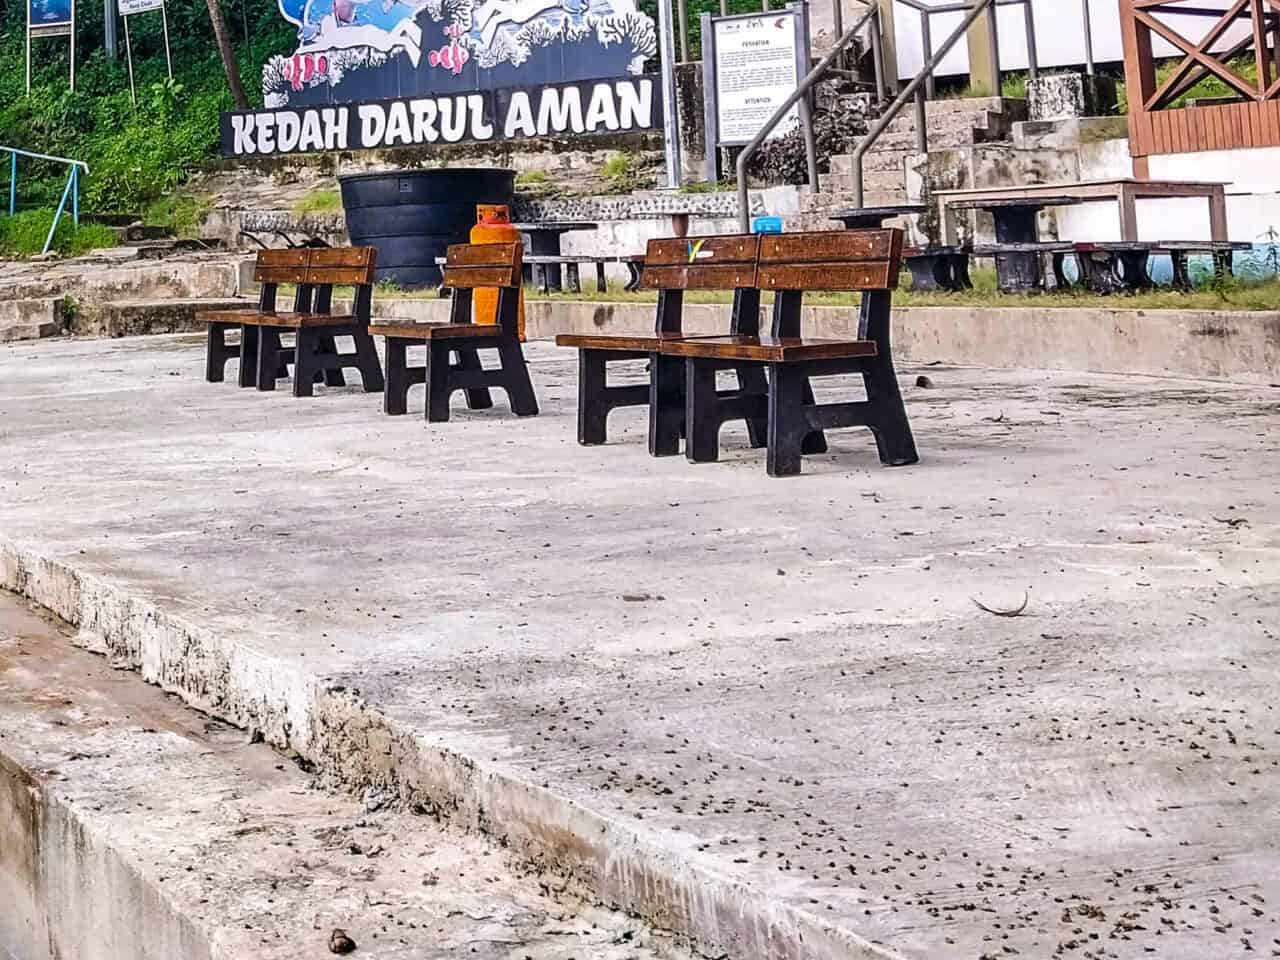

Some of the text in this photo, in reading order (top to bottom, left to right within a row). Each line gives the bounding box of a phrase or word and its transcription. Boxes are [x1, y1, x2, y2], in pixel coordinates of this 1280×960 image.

[232, 79, 653, 155] KEDAH DARUL AMAN
